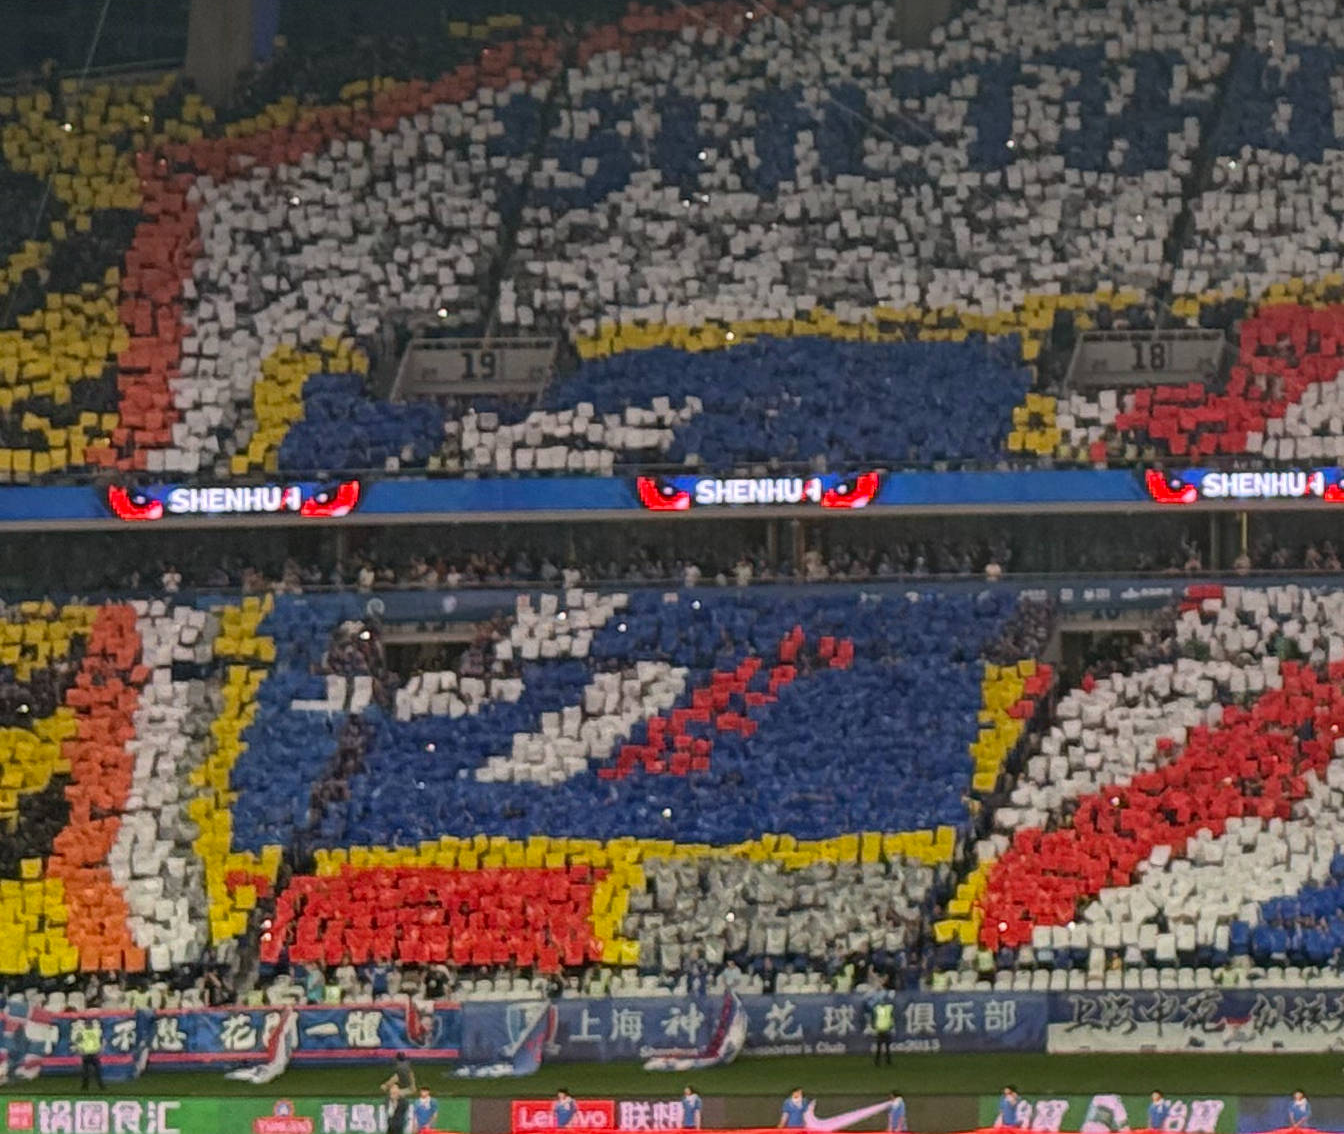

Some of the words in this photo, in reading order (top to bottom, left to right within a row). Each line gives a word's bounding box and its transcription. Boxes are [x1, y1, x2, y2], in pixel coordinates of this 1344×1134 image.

[461, 352, 496, 380] 19
[1131, 342, 1165, 370] 18
[695, 479, 822, 503] SHENHUA
[1202, 472, 1325, 497] SHENHUA
[168, 487, 301, 512] SHENHUA
[568, 1000, 1015, 1043] 上海神花球俱乐部
[37, 1100, 182, 1134] 锅圈食汇
[518, 1106, 608, 1129] Levo
